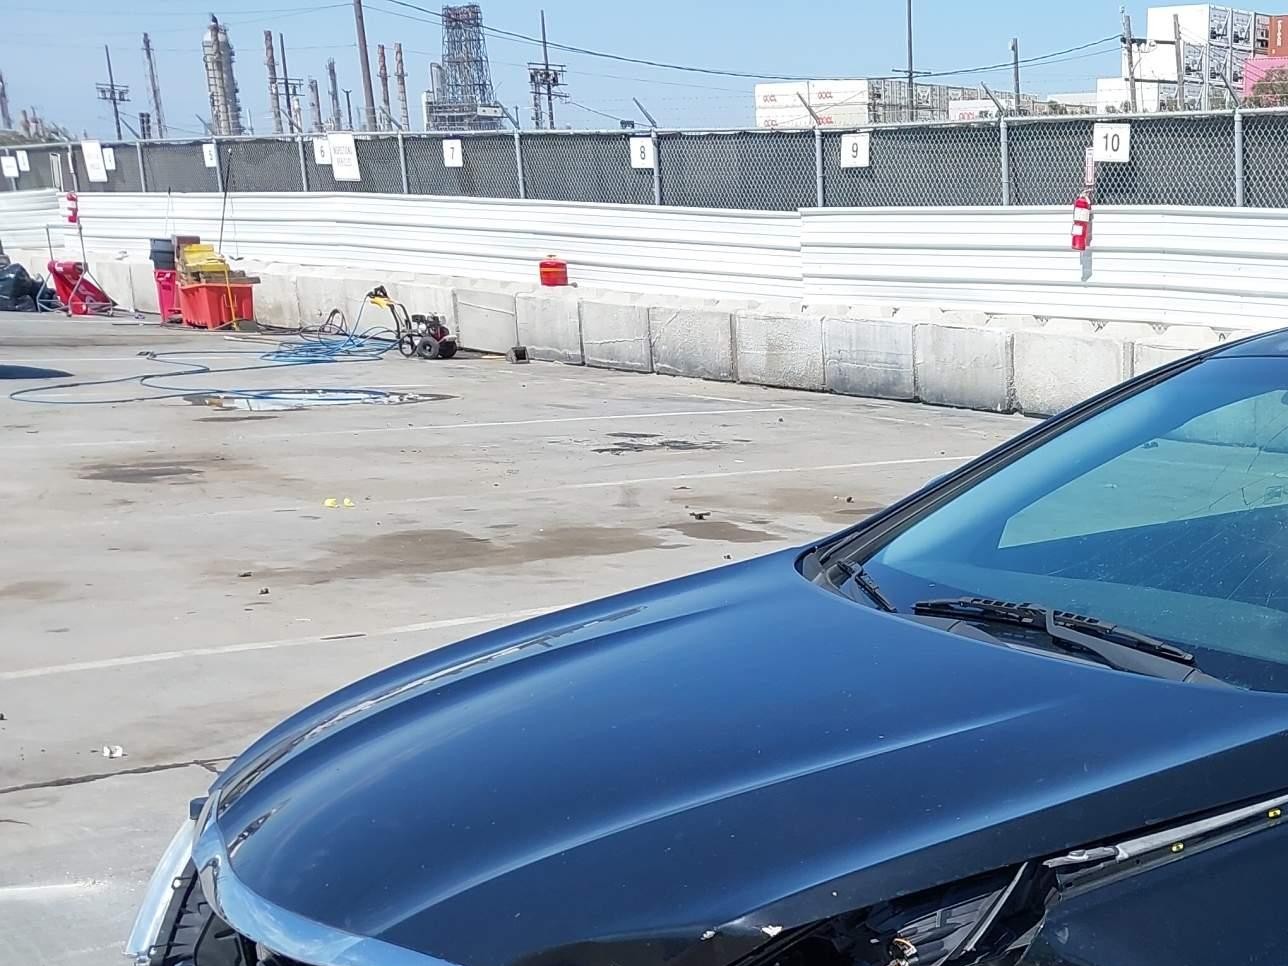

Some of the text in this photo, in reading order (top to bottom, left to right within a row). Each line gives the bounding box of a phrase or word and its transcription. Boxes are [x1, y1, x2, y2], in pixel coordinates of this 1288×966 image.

[851, 142, 859, 158] 9
[1102, 133, 1120, 153] 10
[449, 146, 455, 160] 7
[639, 145, 646, 160] 8
